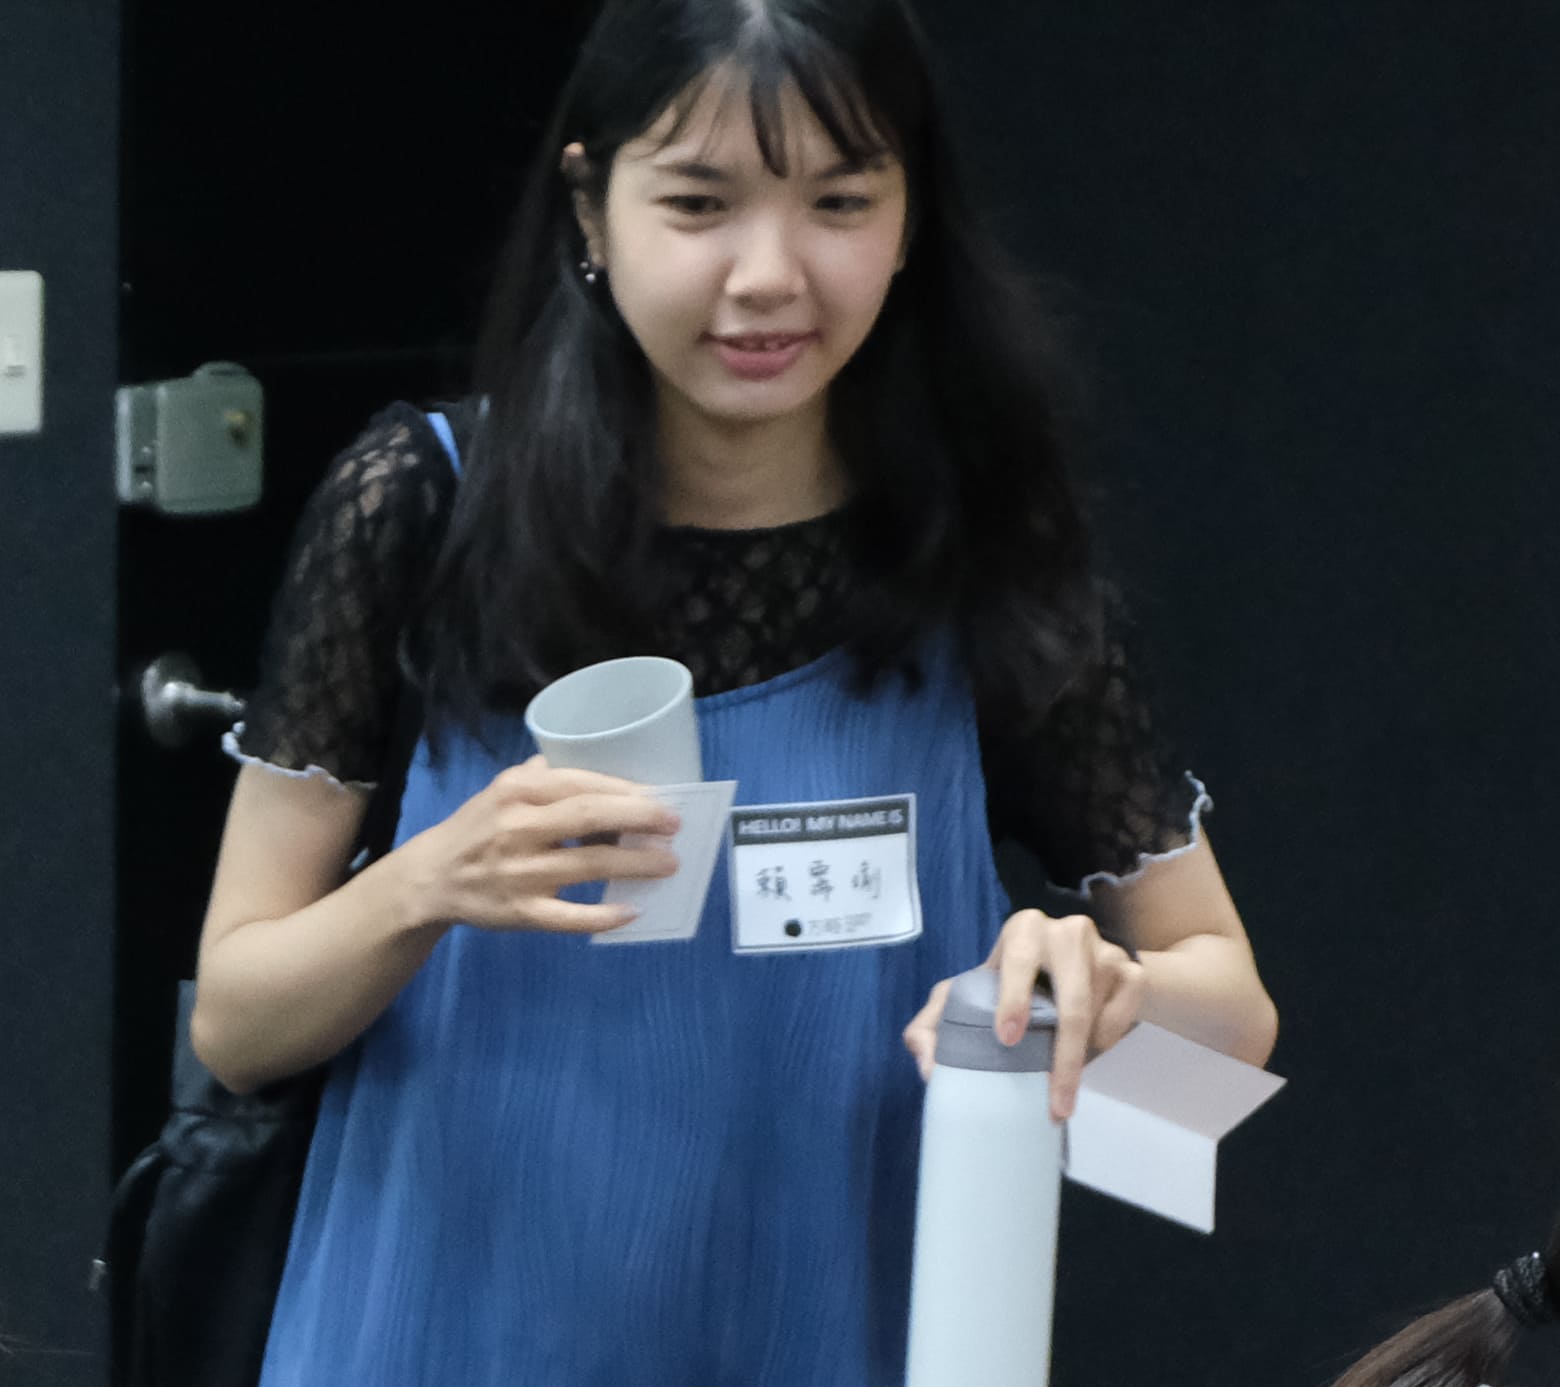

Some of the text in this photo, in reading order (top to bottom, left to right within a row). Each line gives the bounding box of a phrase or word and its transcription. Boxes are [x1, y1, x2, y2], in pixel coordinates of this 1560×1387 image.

[738, 818, 802, 835] HELLO!
[806, 814, 835, 832] MY
[838, 810, 887, 831] NAME
